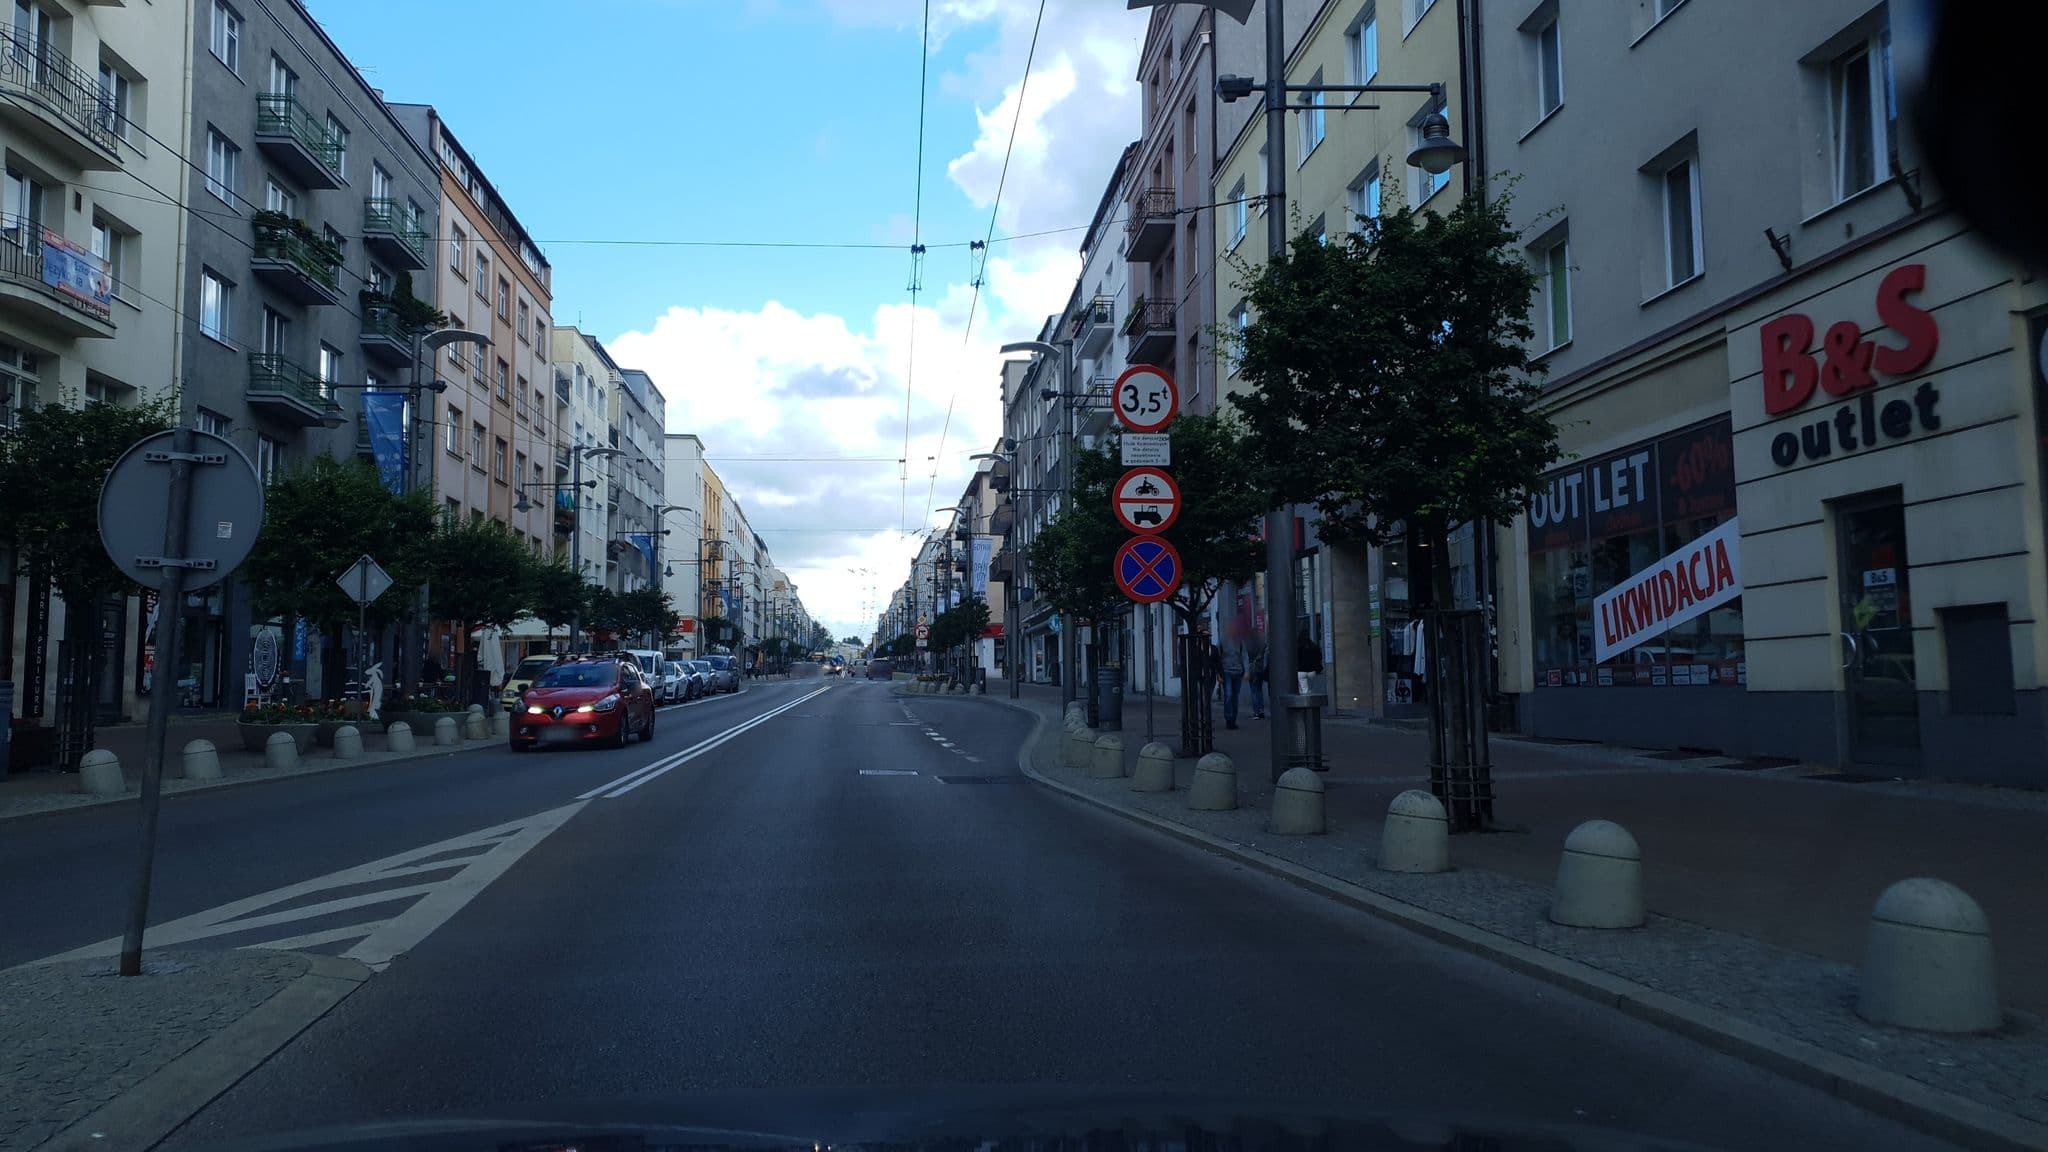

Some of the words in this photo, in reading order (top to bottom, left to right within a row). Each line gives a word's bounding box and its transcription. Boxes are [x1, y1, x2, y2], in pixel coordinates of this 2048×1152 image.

[1760, 264, 1939, 416] B&S
[1771, 381, 1941, 467] outlet
[1602, 538, 1735, 647] LIKWIDACJA
